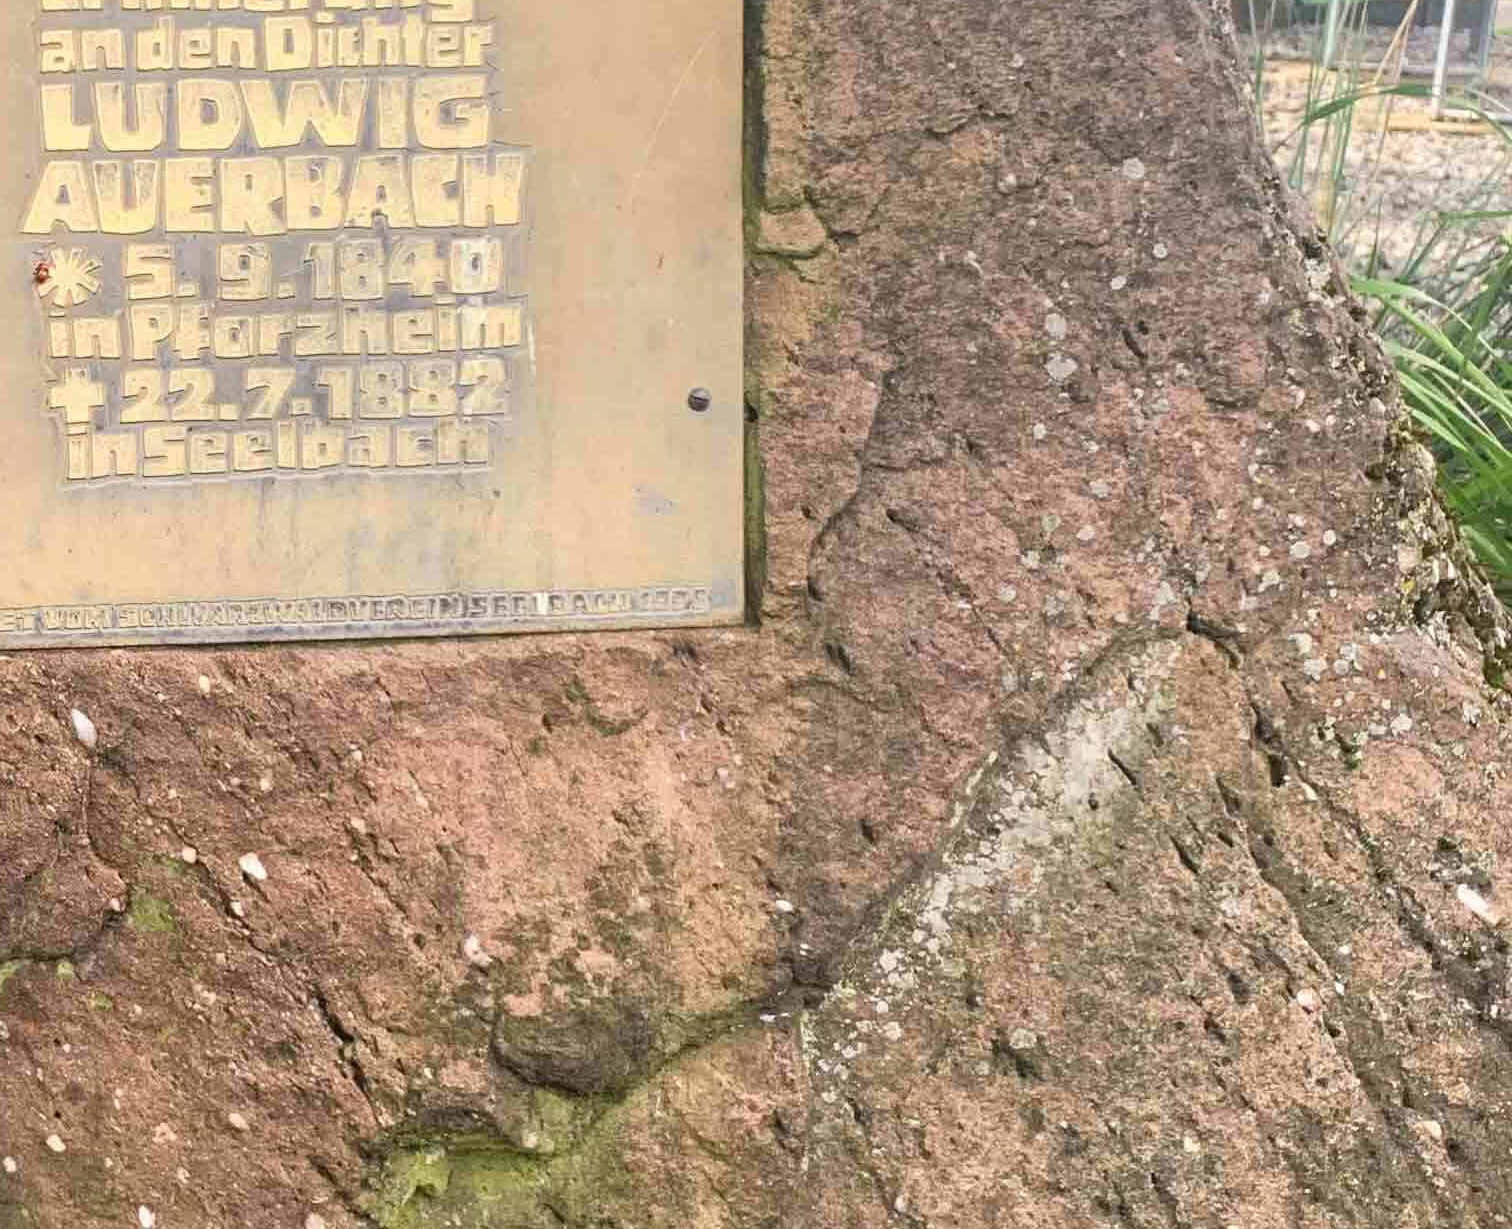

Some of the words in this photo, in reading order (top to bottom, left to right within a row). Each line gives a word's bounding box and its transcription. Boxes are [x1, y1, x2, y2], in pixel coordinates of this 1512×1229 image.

[40, 28, 124, 72] an
[136, 15, 256, 70] den
[265, 10, 494, 71] Dichter
[40, 75, 489, 151] LUDWIG
[20, 153, 524, 235] AUERBACH
[49, 309, 120, 359] in
[127, 298, 522, 361] Pforzheim
[65, 422, 136, 480] in
[142, 418, 488, 477] Seelbach
